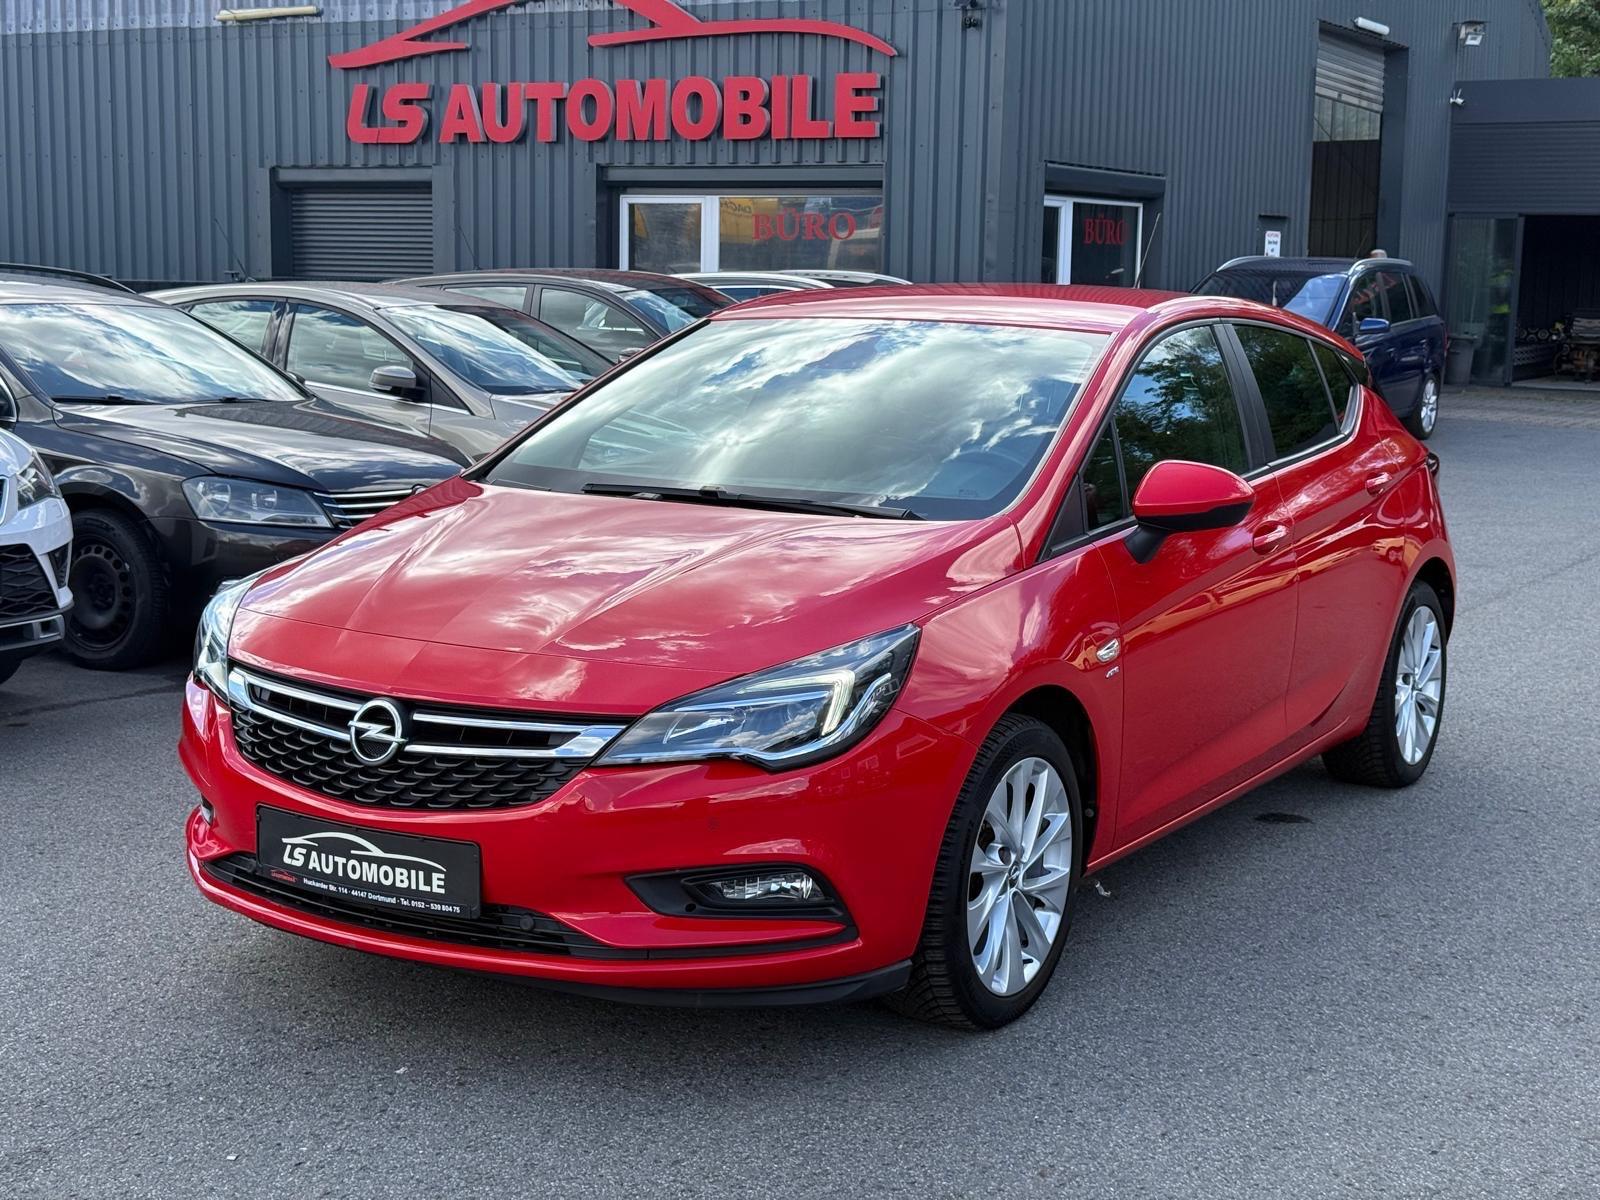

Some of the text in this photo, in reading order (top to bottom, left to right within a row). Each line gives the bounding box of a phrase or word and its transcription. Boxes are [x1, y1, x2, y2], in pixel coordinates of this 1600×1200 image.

[347, 72, 881, 144] LS AUTOMOBILE
[751, 207, 858, 241] BÜRO
[1083, 214, 1129, 246] BÜRO
[282, 844, 446, 894] LS AUTOMOBILE
[351, 889, 367, 898] 44147
[367, 892, 397, 904] Dortmund
[400, 897, 411, 907] Tel.
[411, 900, 426, 909] 0152
